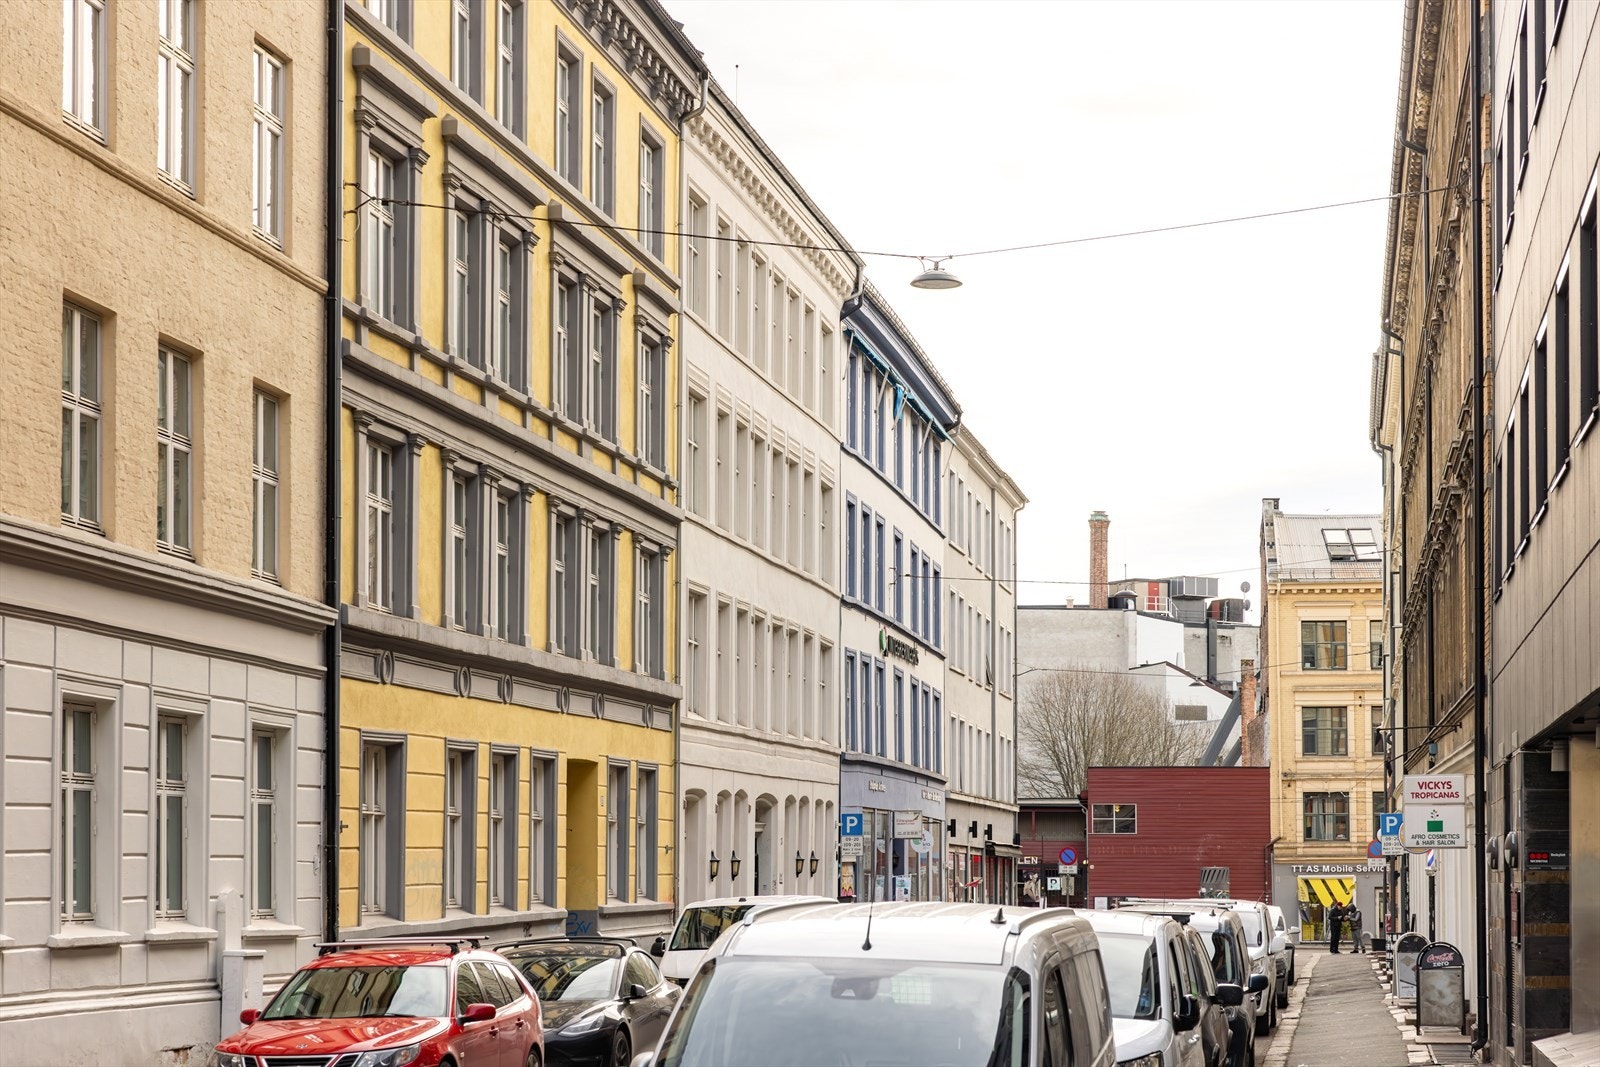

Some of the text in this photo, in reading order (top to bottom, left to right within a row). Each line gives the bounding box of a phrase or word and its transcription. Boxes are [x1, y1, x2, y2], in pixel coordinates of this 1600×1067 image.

[1417, 781, 1452, 790] VICKYS
[846, 816, 858, 833] P
[1386, 816, 1398, 833] P
[1292, 865, 1304, 873] TT
[1306, 865, 1320, 873] AS
[1322, 864, 1353, 873] Mobile
